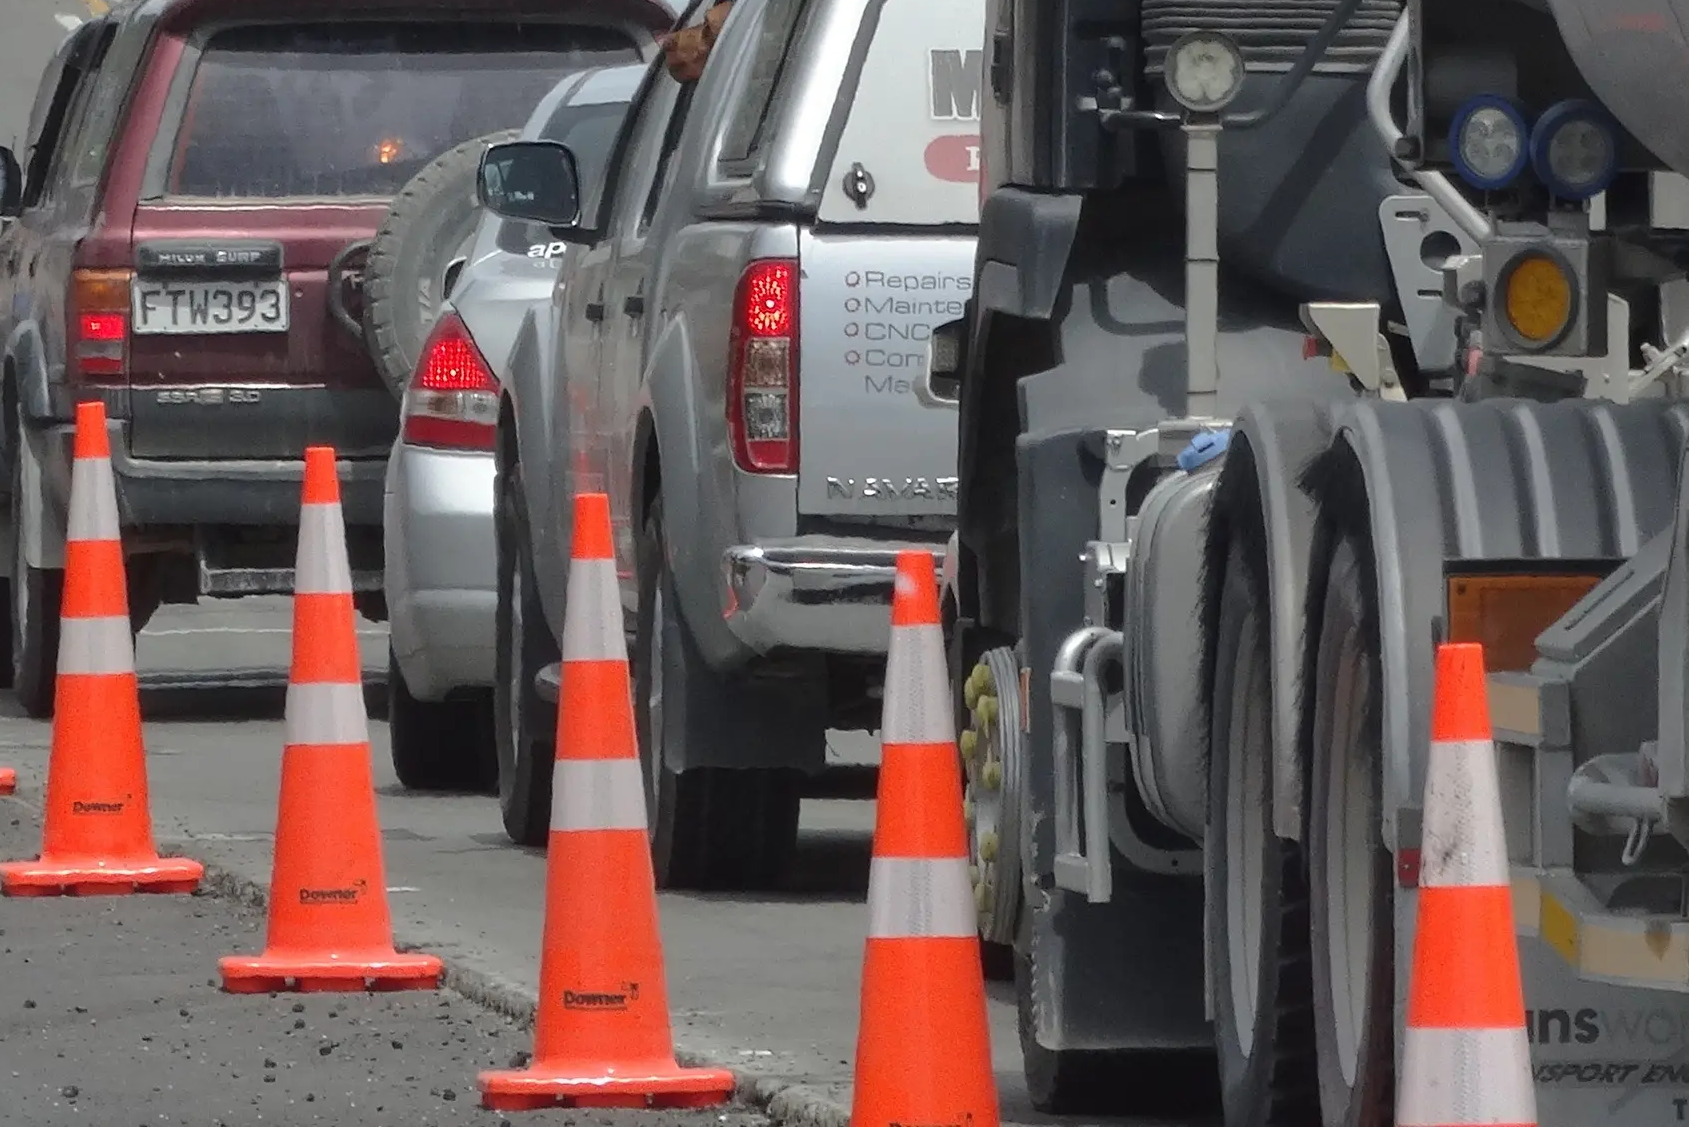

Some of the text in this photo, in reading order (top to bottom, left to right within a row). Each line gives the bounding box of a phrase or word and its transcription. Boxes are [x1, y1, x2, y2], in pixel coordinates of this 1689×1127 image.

[864, 271, 971, 292] Repairs
[141, 289, 281, 325] FTW393
[864, 322, 930, 341] CNC
